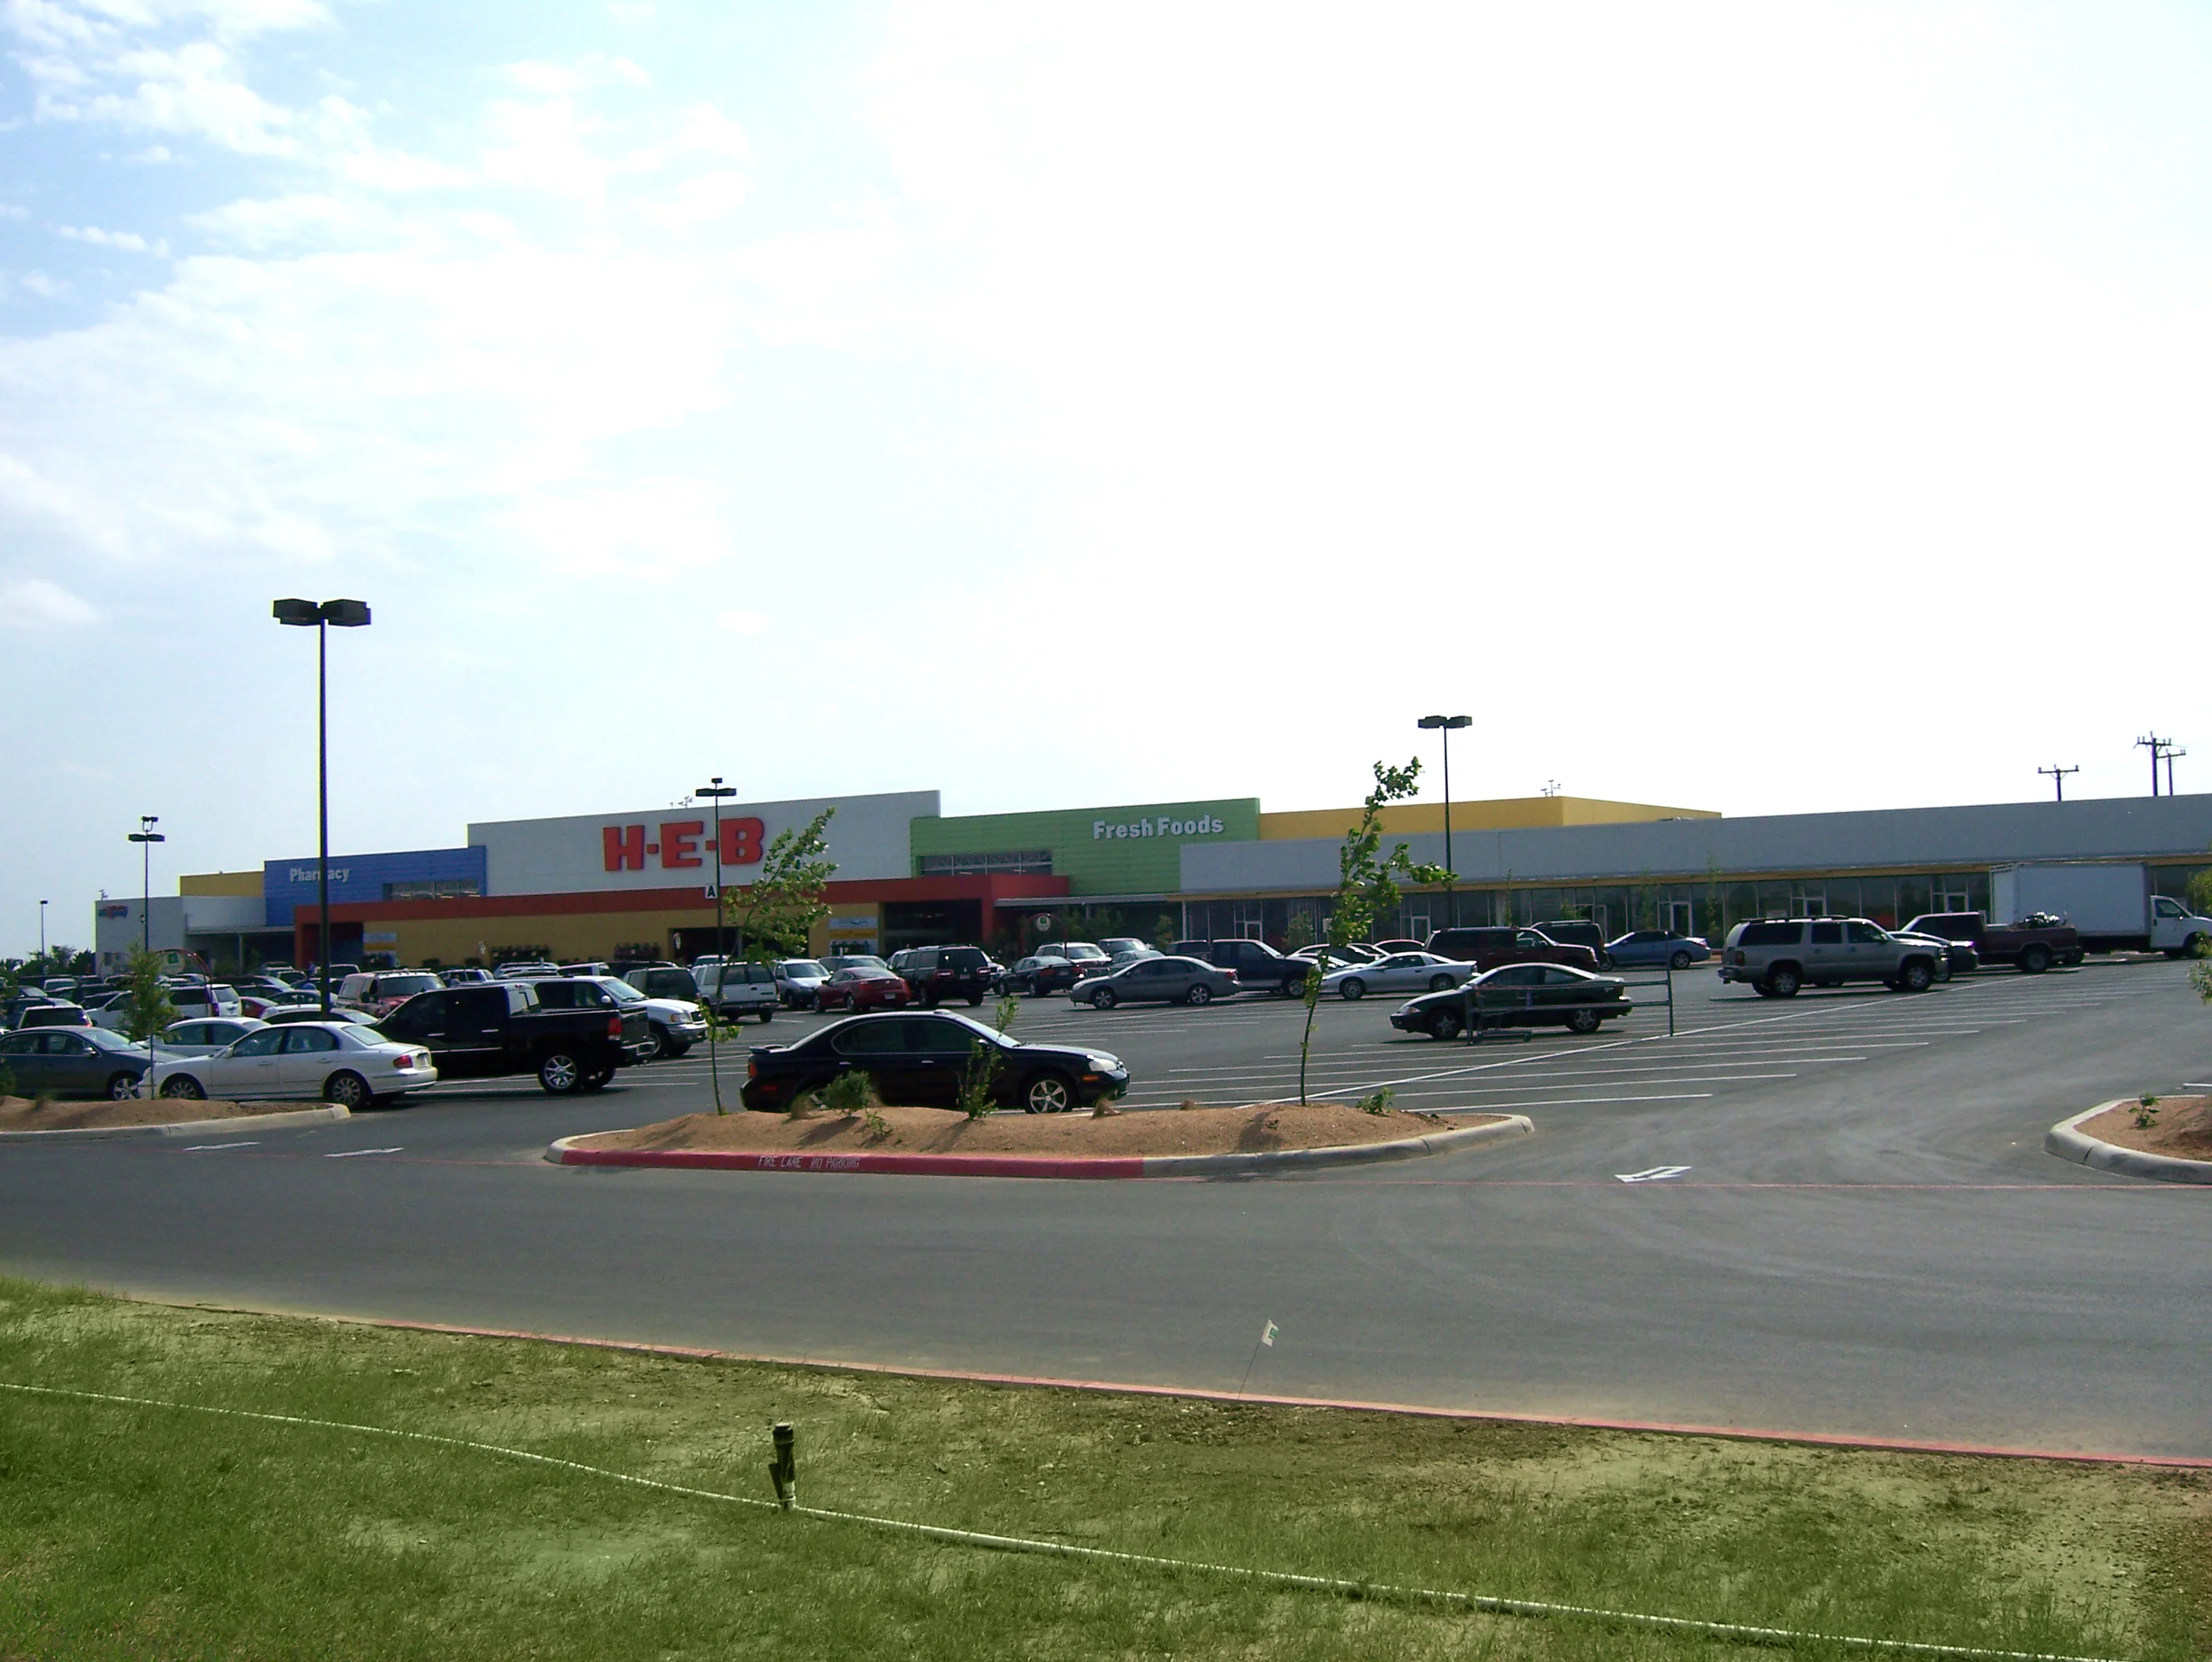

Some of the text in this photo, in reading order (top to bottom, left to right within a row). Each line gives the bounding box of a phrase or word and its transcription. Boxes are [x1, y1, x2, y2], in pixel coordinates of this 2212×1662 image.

[1093, 815, 1225, 840] Fresh Foods
[603, 817, 765, 871] H-E-B
[707, 885, 716, 897] A
[758, 1155, 861, 1169] FIRE LANE NO PARKING
